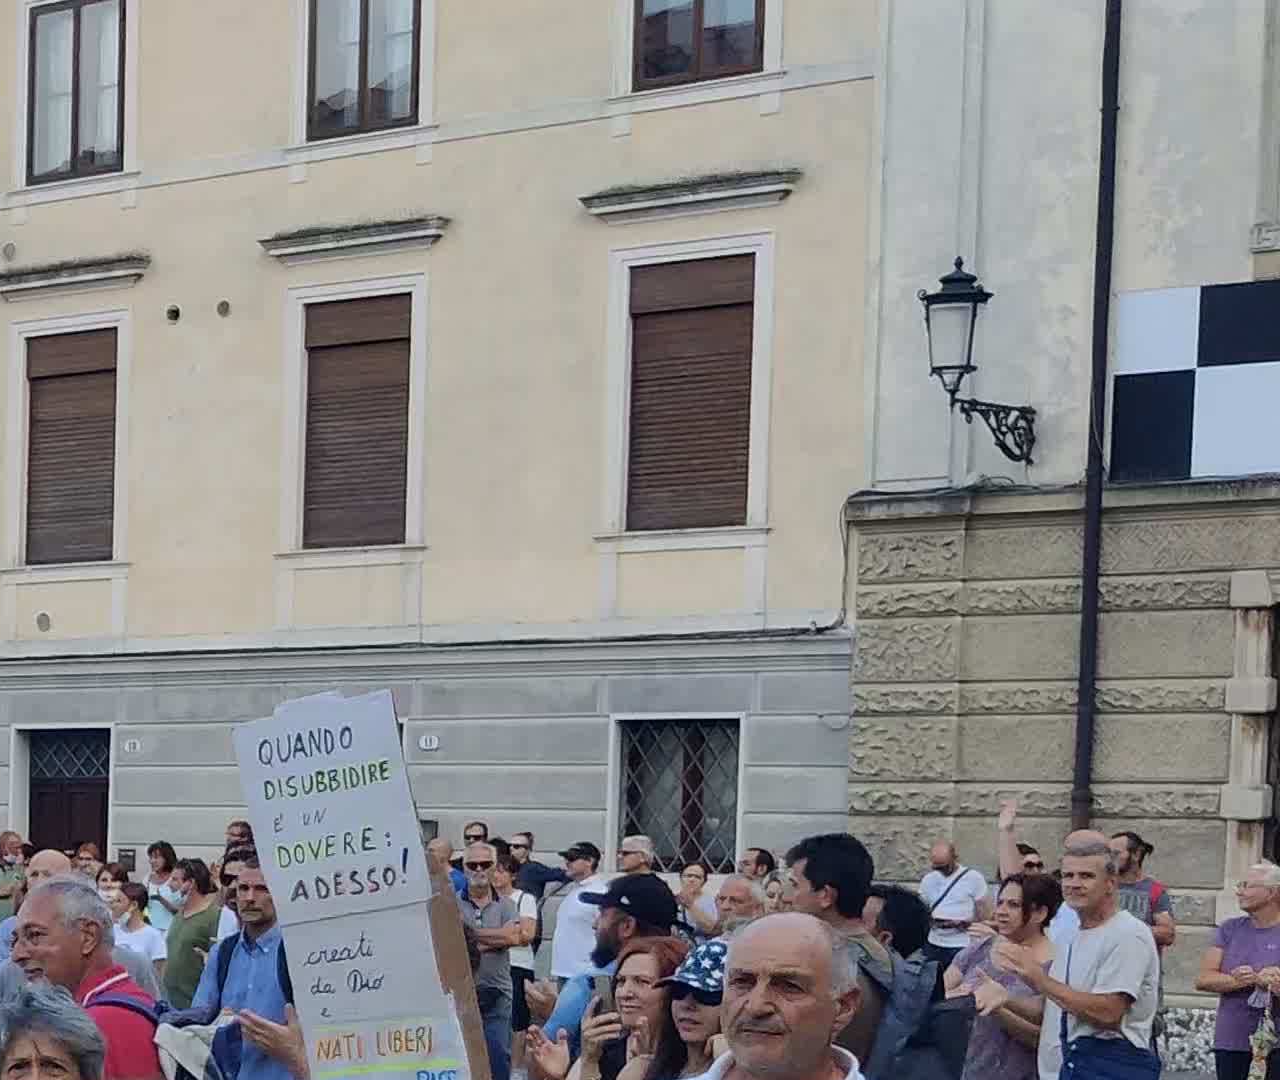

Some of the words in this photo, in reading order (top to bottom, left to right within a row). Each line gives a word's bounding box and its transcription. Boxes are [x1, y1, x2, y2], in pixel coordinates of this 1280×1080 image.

[258, 726, 353, 767] QUANDO
[263, 760, 390, 801] DISUBBIDIRE
[302, 808, 327, 826] UN
[290, 847, 409, 902] ADESSO!
[310, 976, 336, 996] da
[316, 1032, 364, 1062] NATI
[376, 1026, 433, 1057] LIBERI
